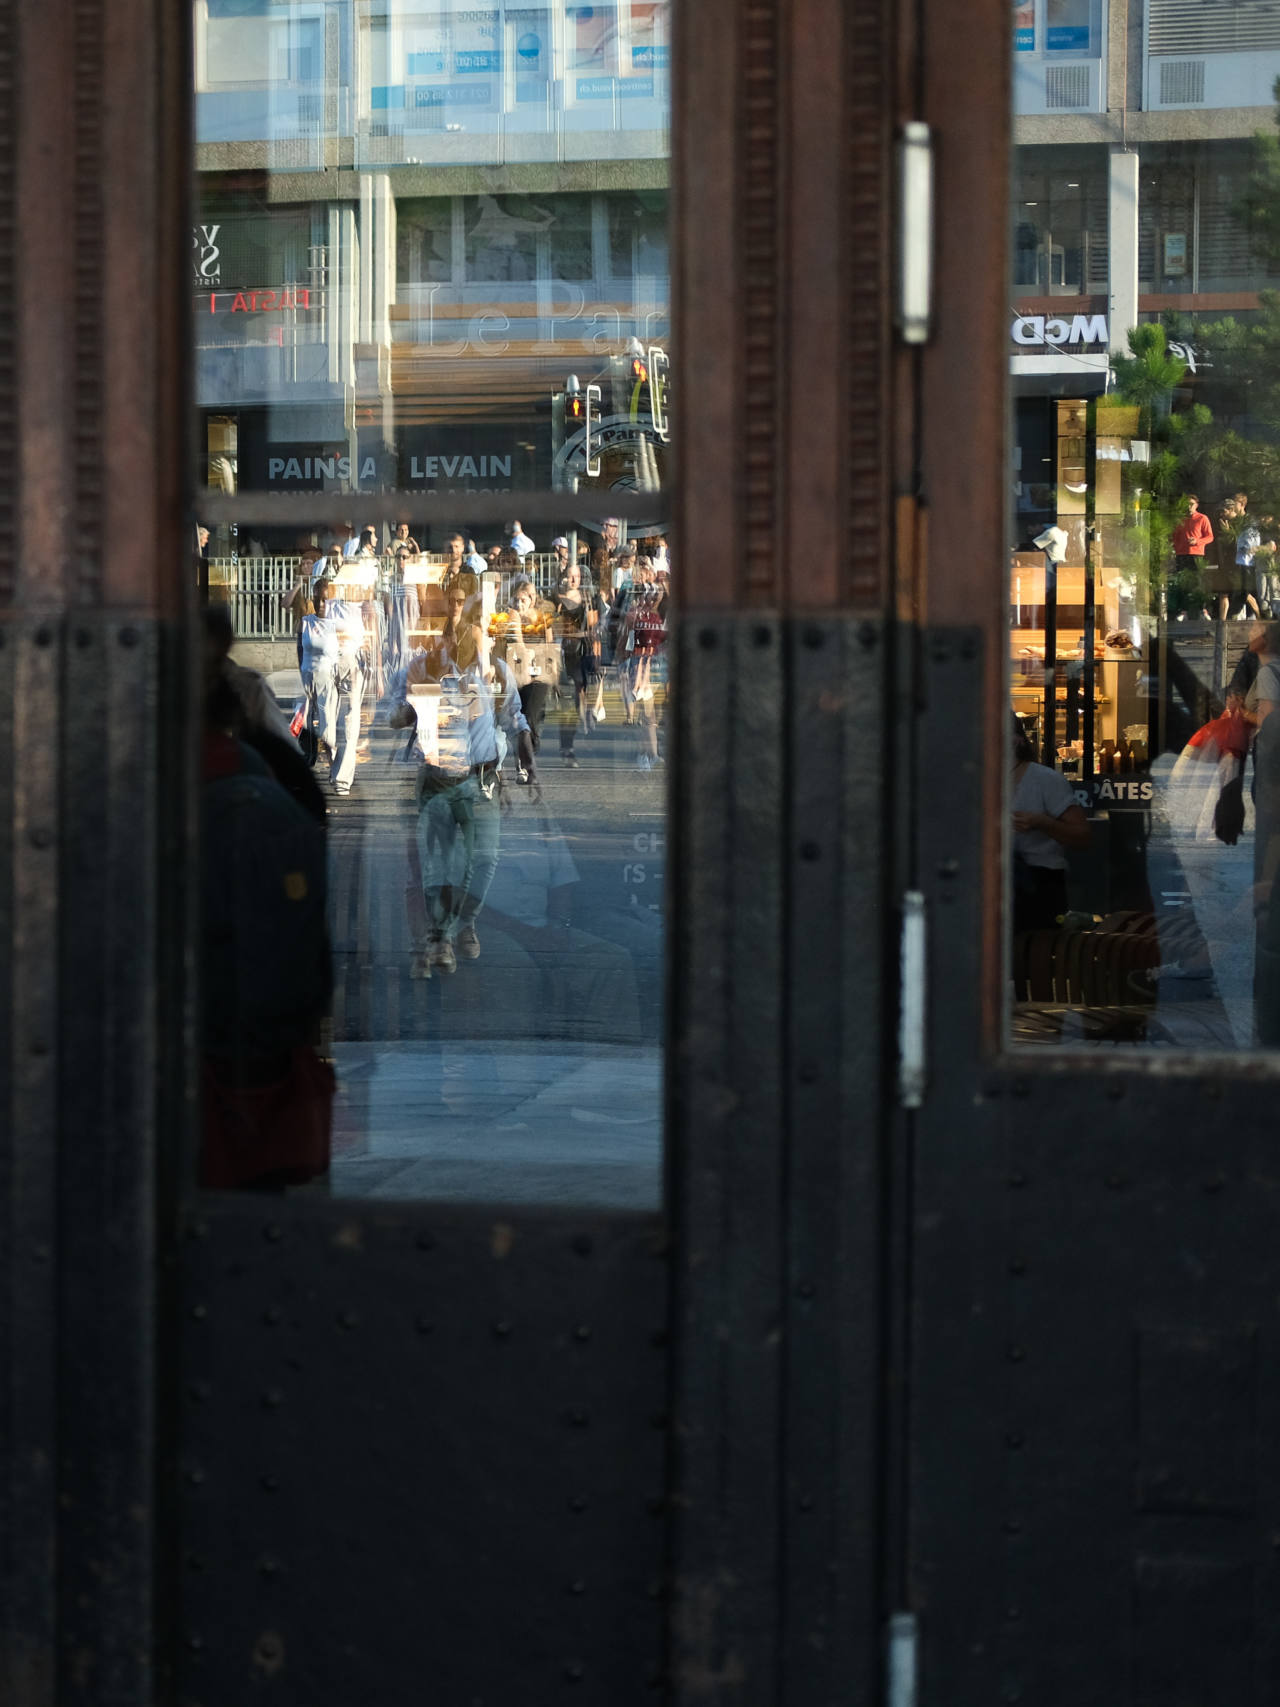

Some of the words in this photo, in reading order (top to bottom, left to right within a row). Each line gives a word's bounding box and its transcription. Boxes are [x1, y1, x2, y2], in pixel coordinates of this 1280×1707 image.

[409, 281, 510, 358] Le
[268, 456, 351, 480] PAINS
[410, 455, 512, 480] LEVAIN
